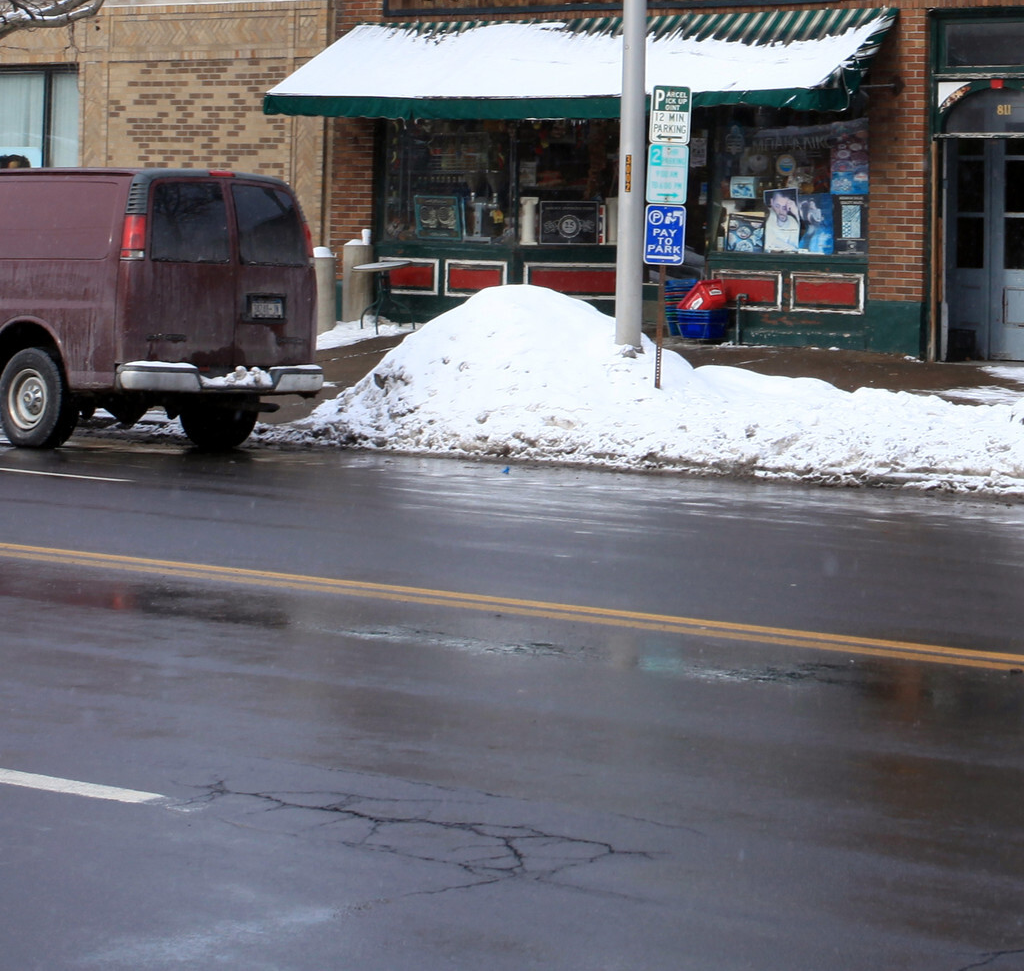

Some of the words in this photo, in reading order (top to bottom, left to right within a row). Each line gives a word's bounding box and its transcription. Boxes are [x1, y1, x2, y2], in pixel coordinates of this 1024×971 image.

[996, 105, 1011, 116] 811
[655, 112, 665, 122] 12
[668, 113, 685, 122] MIN
[653, 124, 687, 134] PARKING
[652, 148, 661, 163] 2
[653, 228, 677, 237] PAY
[657, 237, 673, 245] TO
[648, 244, 680, 254] PARK
